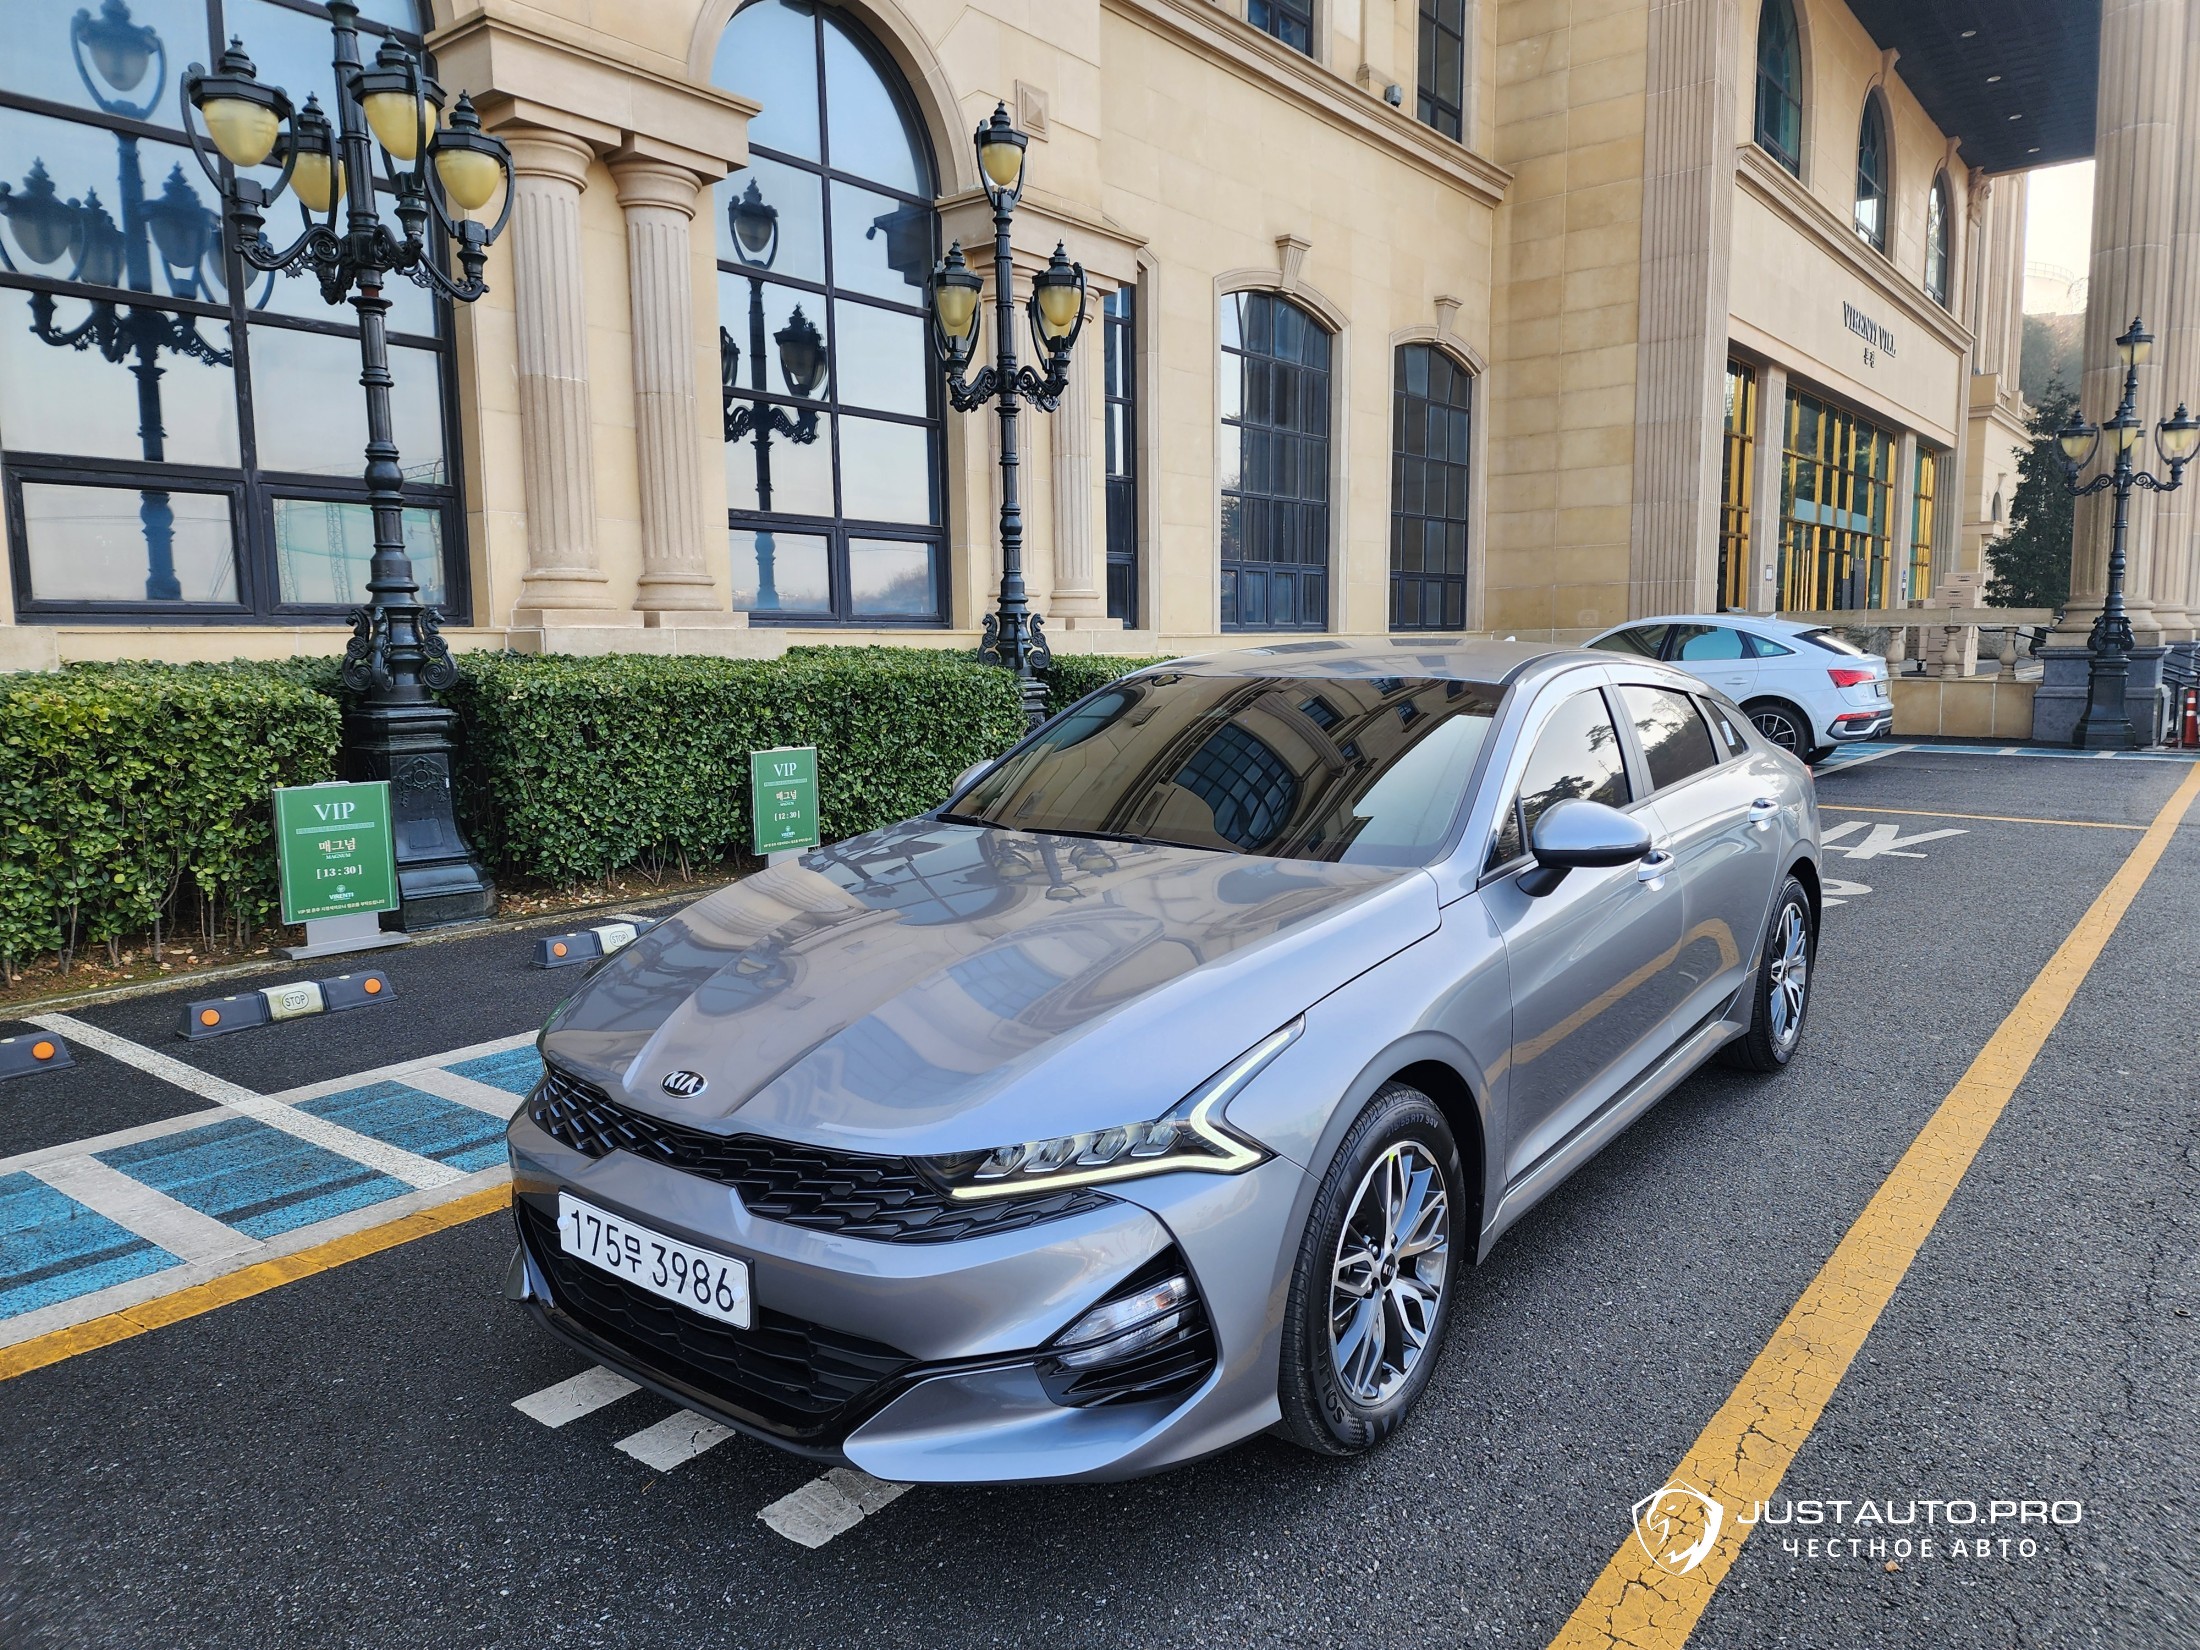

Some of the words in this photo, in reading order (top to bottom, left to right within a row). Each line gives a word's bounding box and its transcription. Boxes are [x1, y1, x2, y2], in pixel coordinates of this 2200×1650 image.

[773, 762, 797, 777] VIP
[313, 801, 355, 821] VIP
[318, 837, 356, 853] 매그넘
[284, 994, 306, 1007] STOP
[663, 1070, 700, 1094] KIA
[650, 1242, 735, 1312] 3986
